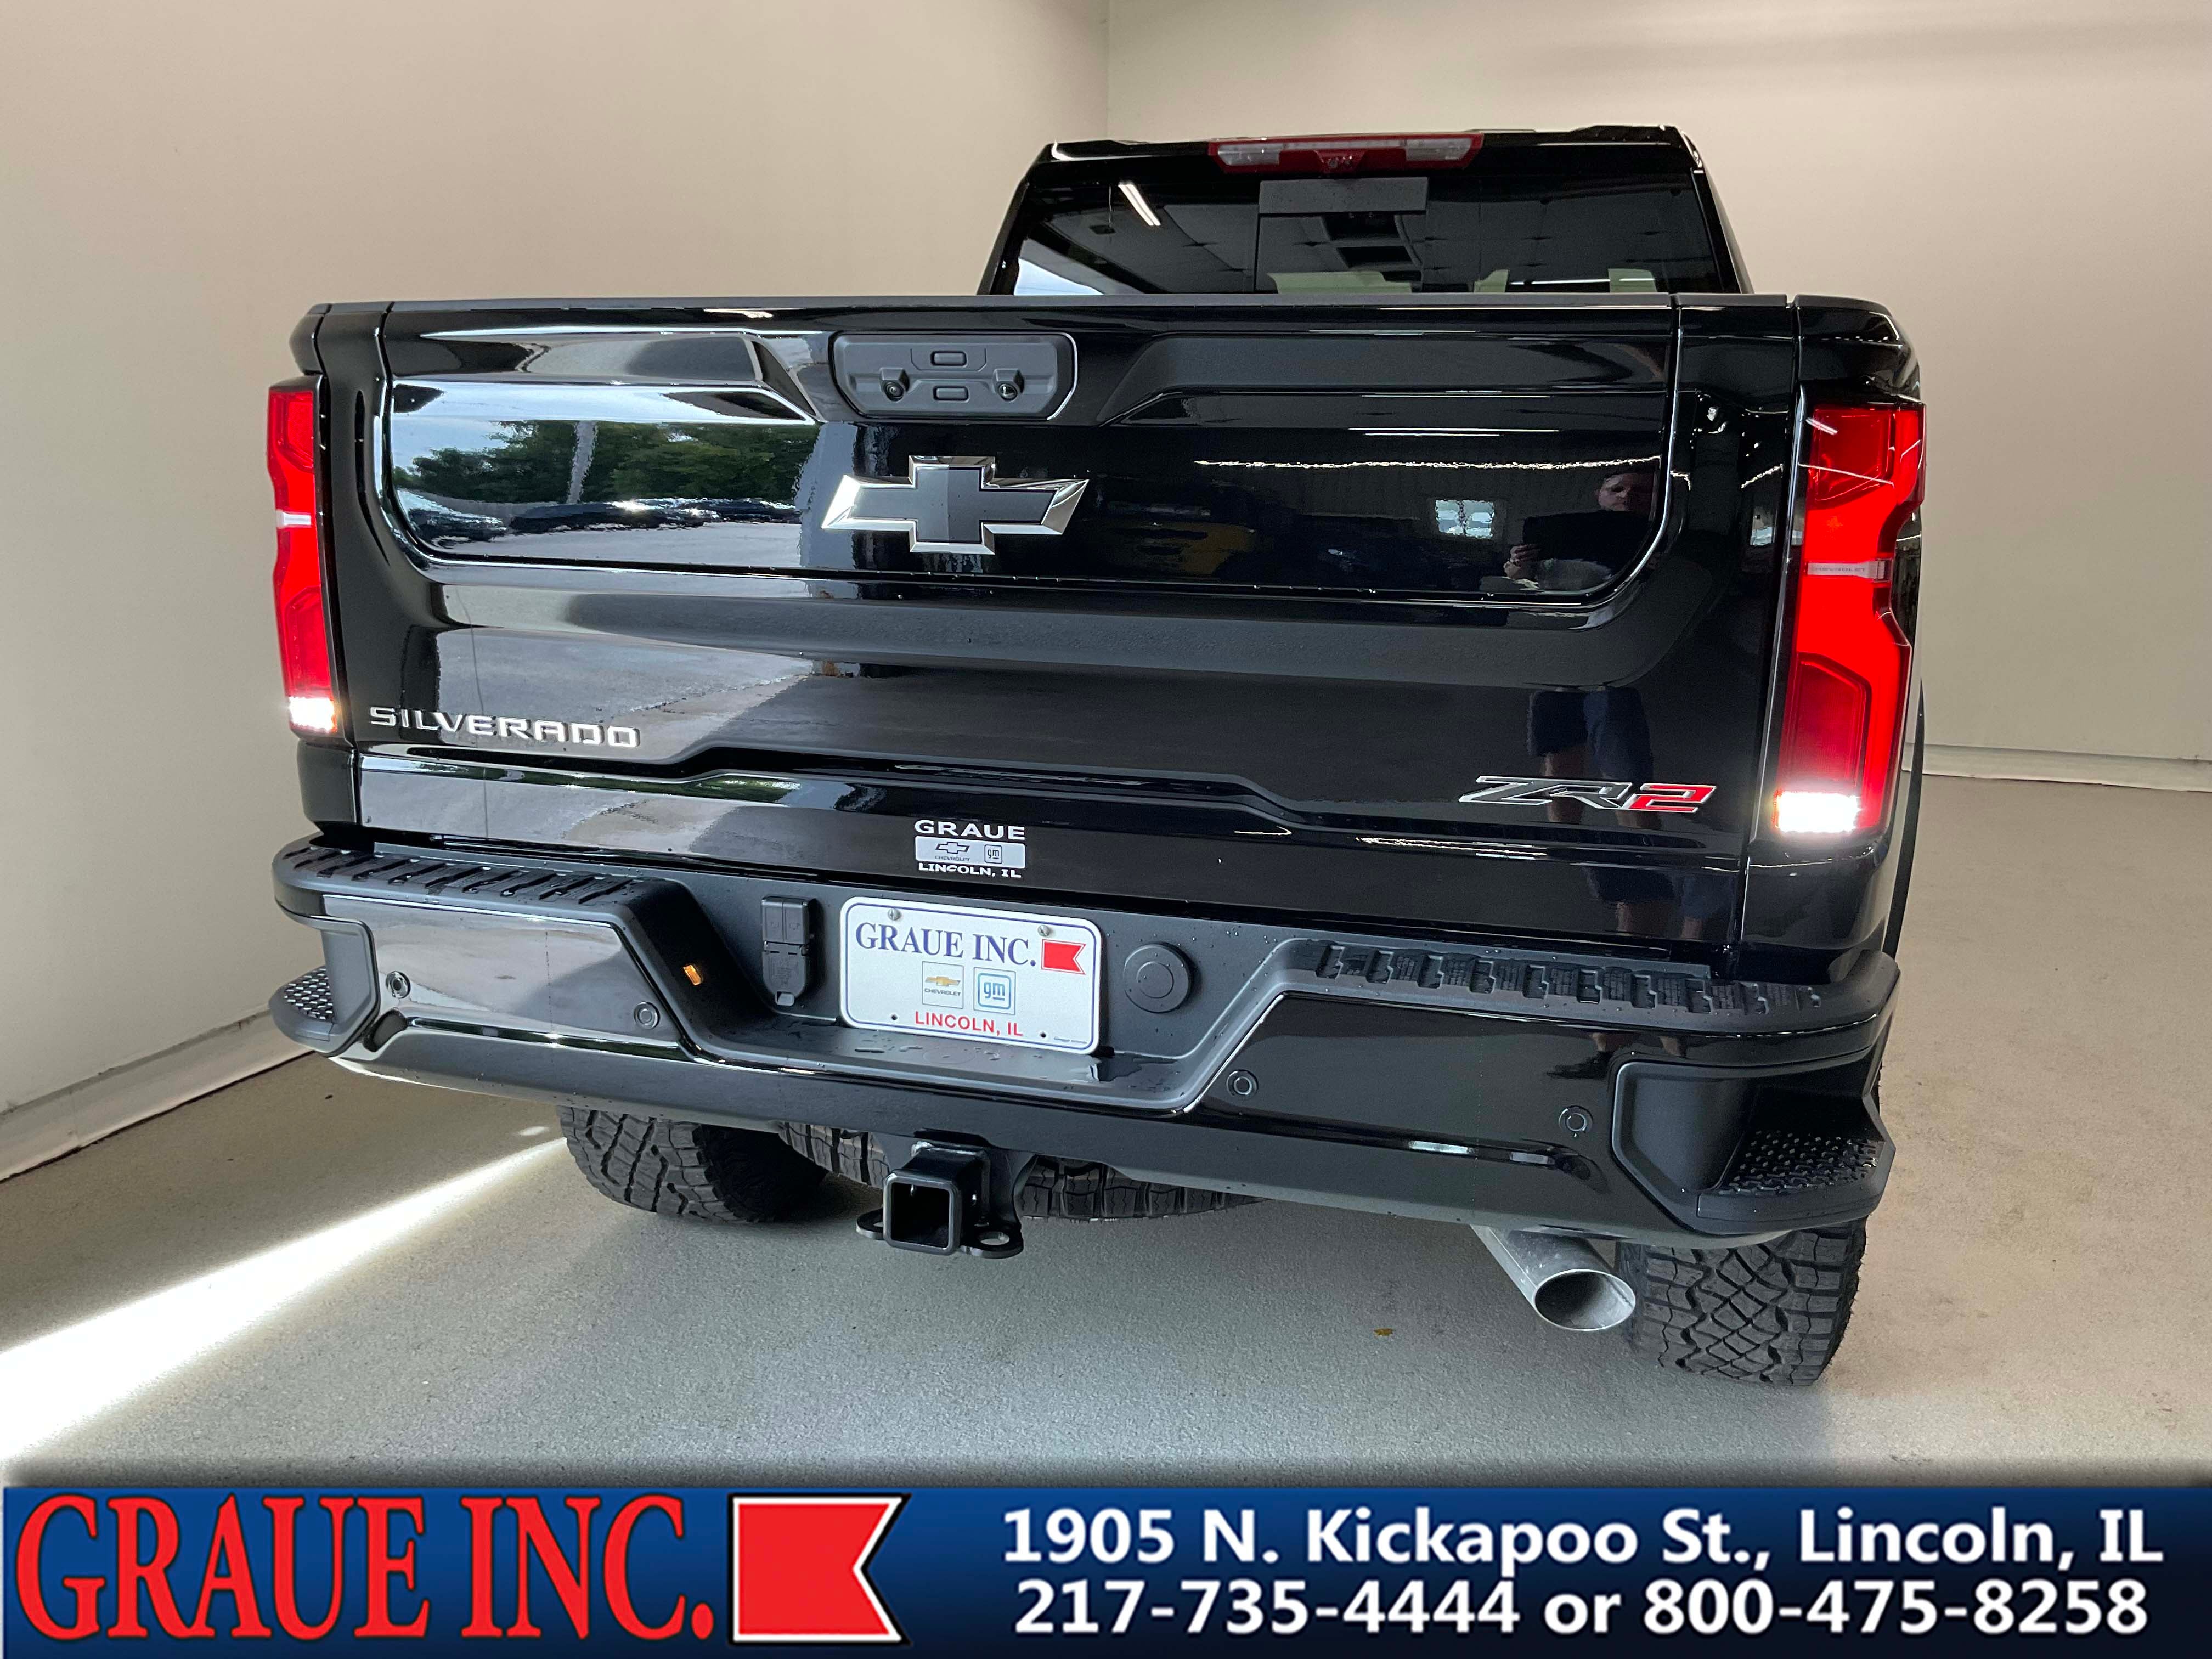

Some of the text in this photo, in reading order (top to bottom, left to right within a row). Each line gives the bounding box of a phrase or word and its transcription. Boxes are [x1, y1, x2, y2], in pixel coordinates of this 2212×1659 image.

[370, 706, 640, 748] SILVERADO
[1458, 775, 1717, 814] ZR2
[914, 820, 1026, 840] GRAUE
[987, 849, 1000, 860] gm
[918, 862, 1022, 878] LINCOLN, IL
[855, 922, 1036, 966] GRAUE INC.
[924, 988, 961, 996] CHEVROLET
[983, 981, 1006, 1001] gm
[915, 1012, 1023, 1036] LINCOLN, IL
